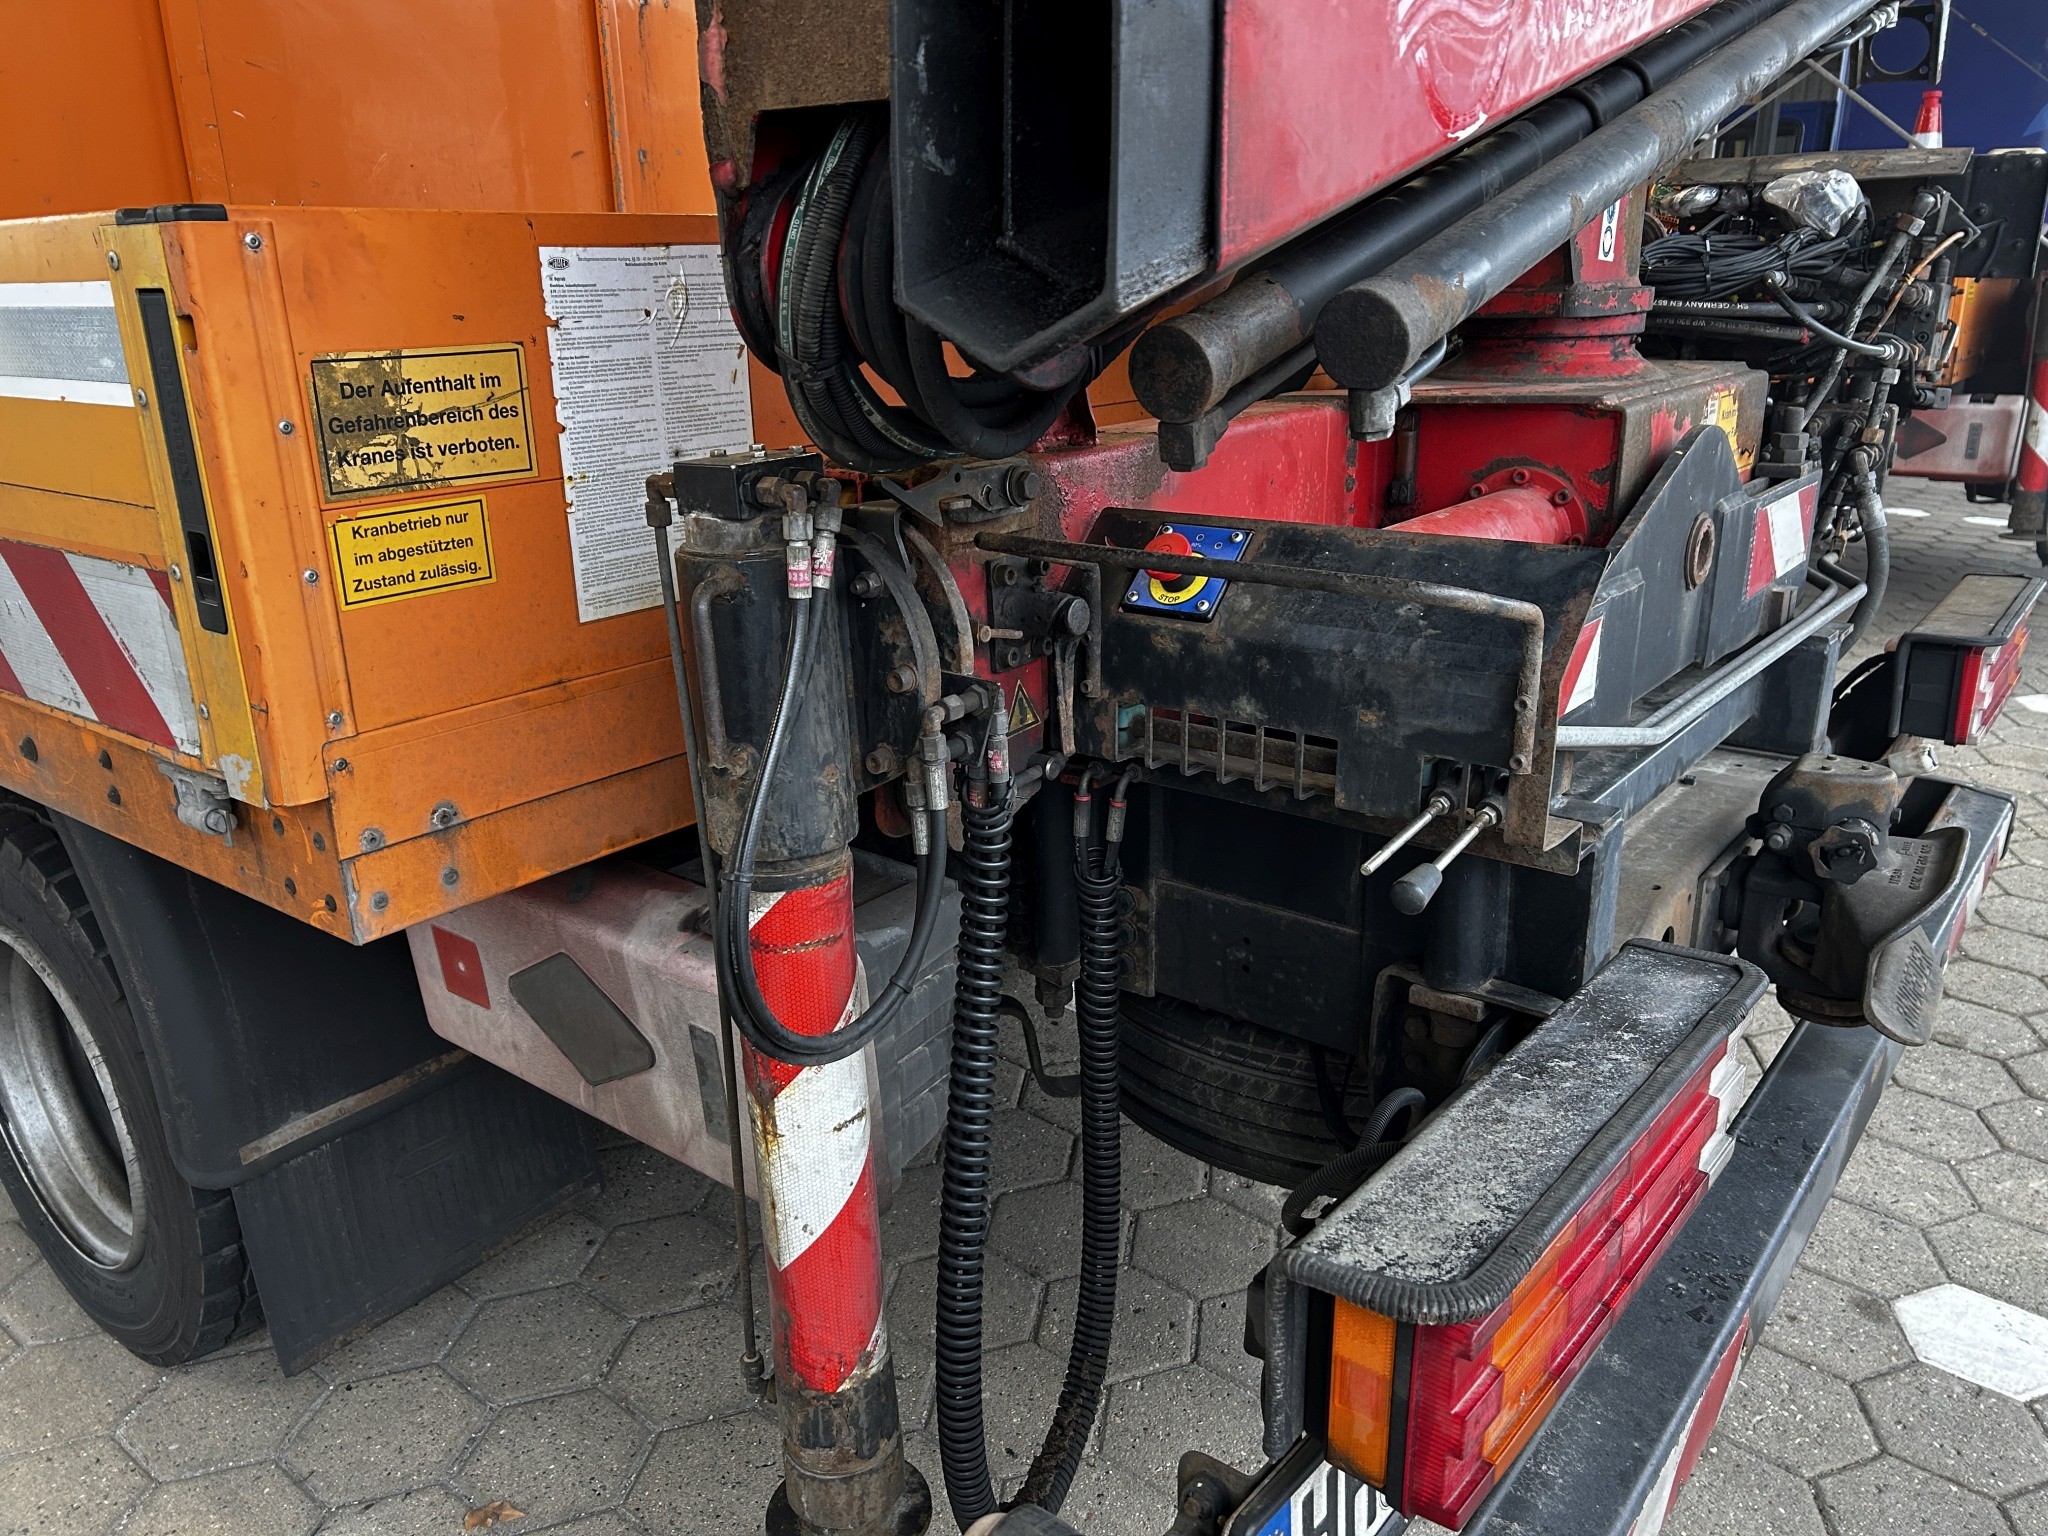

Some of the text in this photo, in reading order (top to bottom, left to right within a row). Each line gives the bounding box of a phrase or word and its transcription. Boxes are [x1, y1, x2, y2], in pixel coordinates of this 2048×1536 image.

[783, 285, 789, 300] mm
[789, 219, 800, 240] DN10
[1685, 301, 1730, 310] GERMANY
[1692, 319, 1706, 327] WP
[340, 372, 501, 400] Der Aufenthalt im
[328, 402, 519, 435] Gefahrenbereich des
[336, 436, 520, 468] Kranes ist verboten.
[351, 512, 469, 540] Kranbetrieb nur
[353, 536, 474, 566] im abgestützten
[352, 560, 482, 593] Zustand zulässig.
[1158, 594, 1180, 603] STOP
